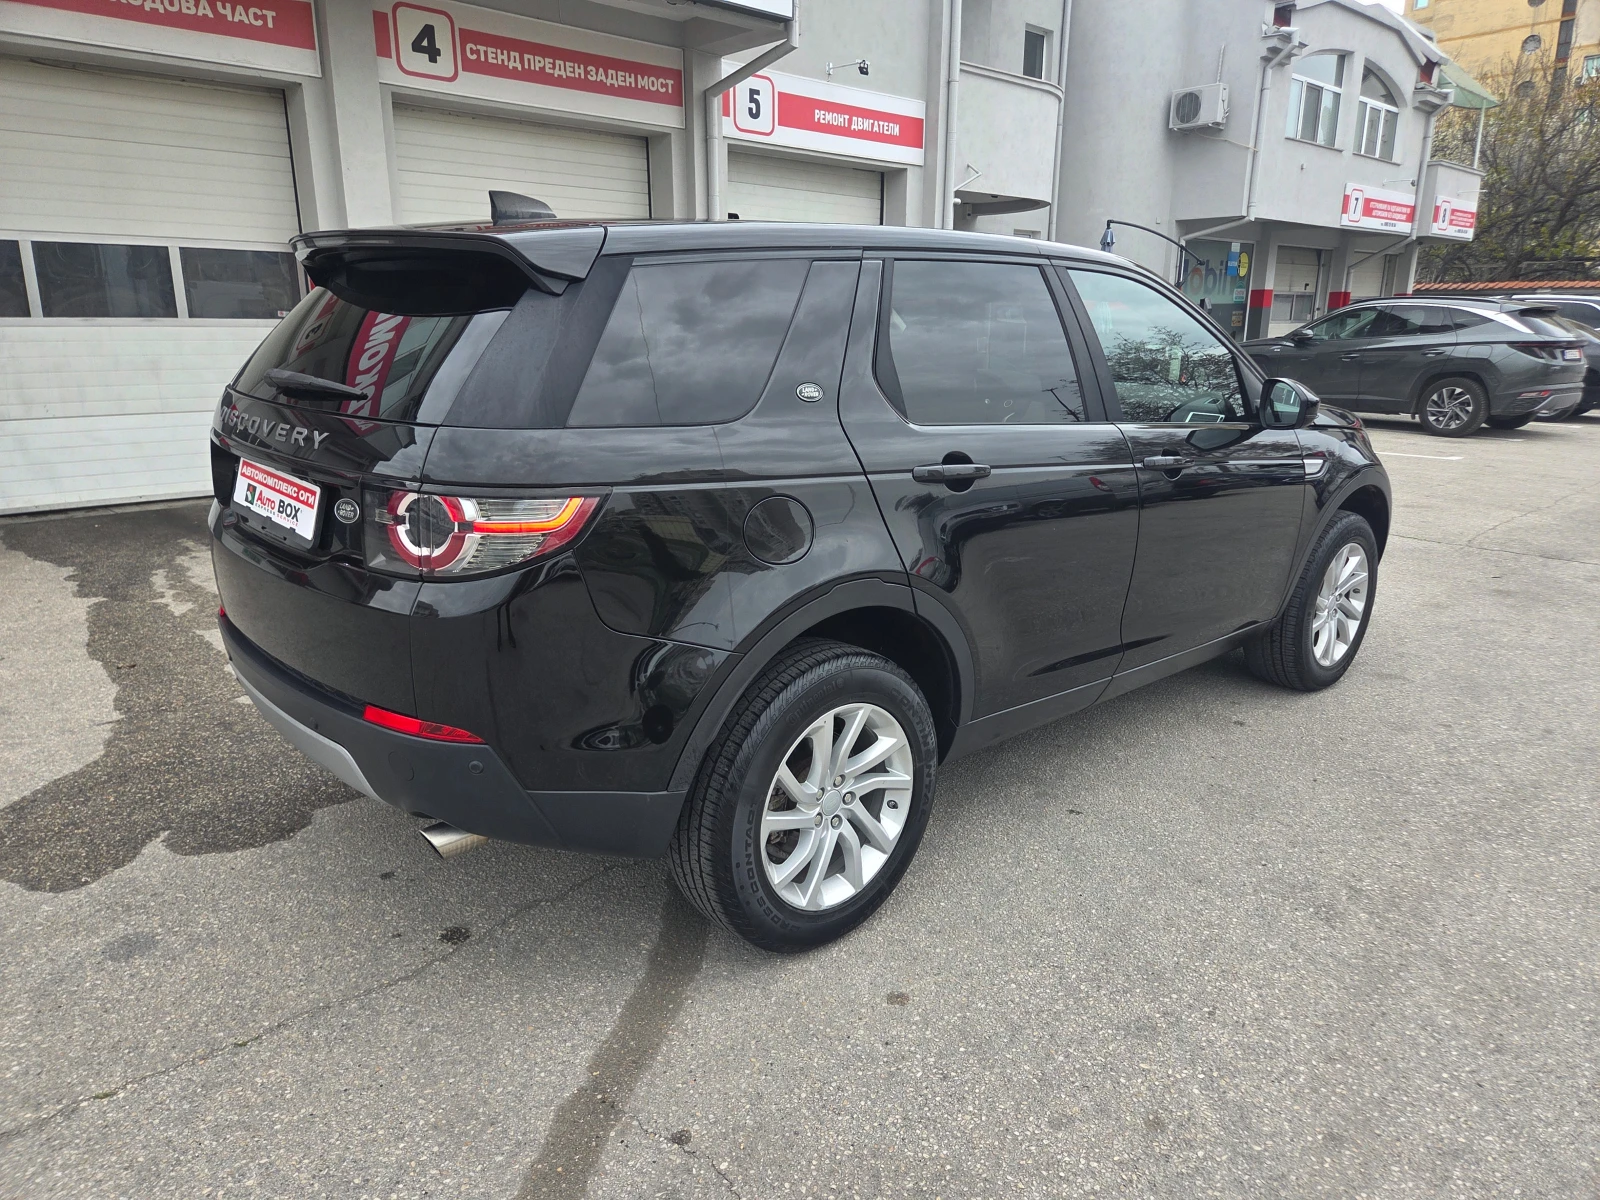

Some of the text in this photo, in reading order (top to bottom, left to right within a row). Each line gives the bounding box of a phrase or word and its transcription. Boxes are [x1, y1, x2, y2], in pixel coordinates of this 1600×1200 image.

[216, 2, 276, 28] ЧАСТ
[411, 24, 441, 64] 4
[466, 43, 674, 94] СТЕНД ПРЕДЕН ЗАДЕН МОСТ
[748, 88, 761, 119] 5
[814, 109, 900, 136] РЕМОНТ ДВИГАТЕЛИ
[1353, 197, 1360, 214] 7
[1442, 208, 1447, 224] 8
[220, 405, 330, 449] DISCOVERY
[241, 464, 316, 506] АВТОКОМПЛЕКС ОГИ
[277, 498, 300, 522] BOX
[339, 502, 352, 511] LAND
[340, 509, 355, 519] ROVER
